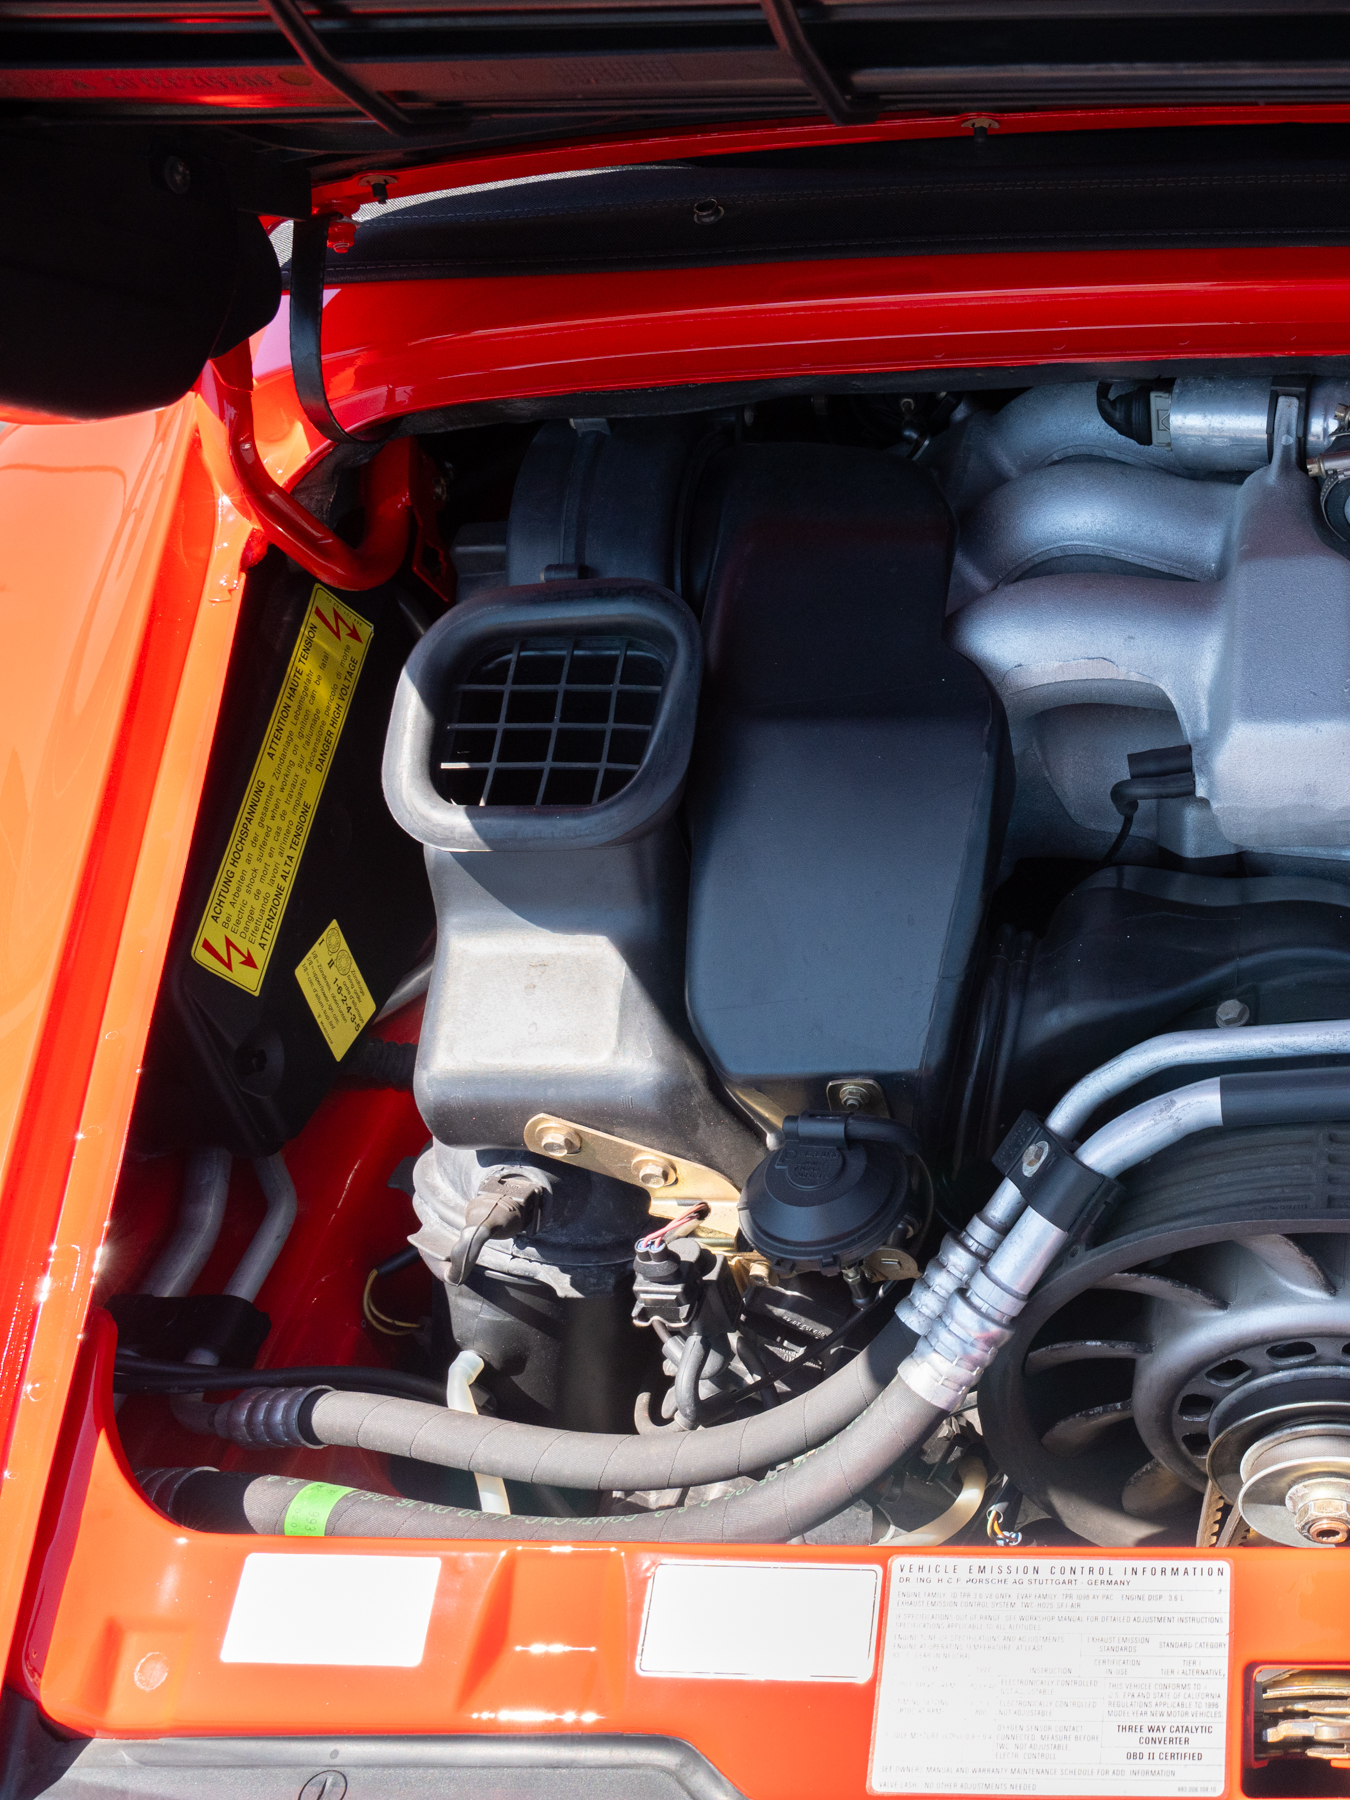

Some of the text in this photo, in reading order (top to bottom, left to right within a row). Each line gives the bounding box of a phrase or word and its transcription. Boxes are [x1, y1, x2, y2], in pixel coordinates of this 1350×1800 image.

[267, 623, 316, 759] ATTENTION HAUTE TENSION
[315, 656, 357, 772] DANGER HIGH VOLTAGE
[211, 780, 264, 922] ACHTUNG HOCHSPANNUNG
[221, 669, 313, 929] Bei Arbeiten an der gesamten Zündanlage Lebensgefahr
[230, 651, 328, 934] Electric shock suffered when working on ignition can be fatal
[239, 905, 254, 939] Danger
[253, 888, 261, 900] de
[259, 862, 270, 883] mort
[268, 846, 275, 858] en
[273, 825, 282, 841] cas
[279, 809, 287, 821] de
[284, 773, 298, 804] travaux
[302, 708, 320, 750] l'allumage
[248, 644, 350, 944] Effettuando lavori all'intero impianto d'accensione pericolo di morte
[258, 801, 310, 949] ATTENZIONE ALTA TENSIONE
[333, 978, 360, 1031] 1-6-2-4-3-5
[900, 1564, 1224, 1576] VEHICLE EMISSION CONTROL INFORMATION
[1027, 1578, 1078, 1586] STUTTGART
[1117, 1725, 1213, 1734] THREE WAY CATALYTIC
[1126, 1752, 1203, 1760] OBD II CERTIFIED
[1139, 1737, 1190, 1745] CONVERTER
